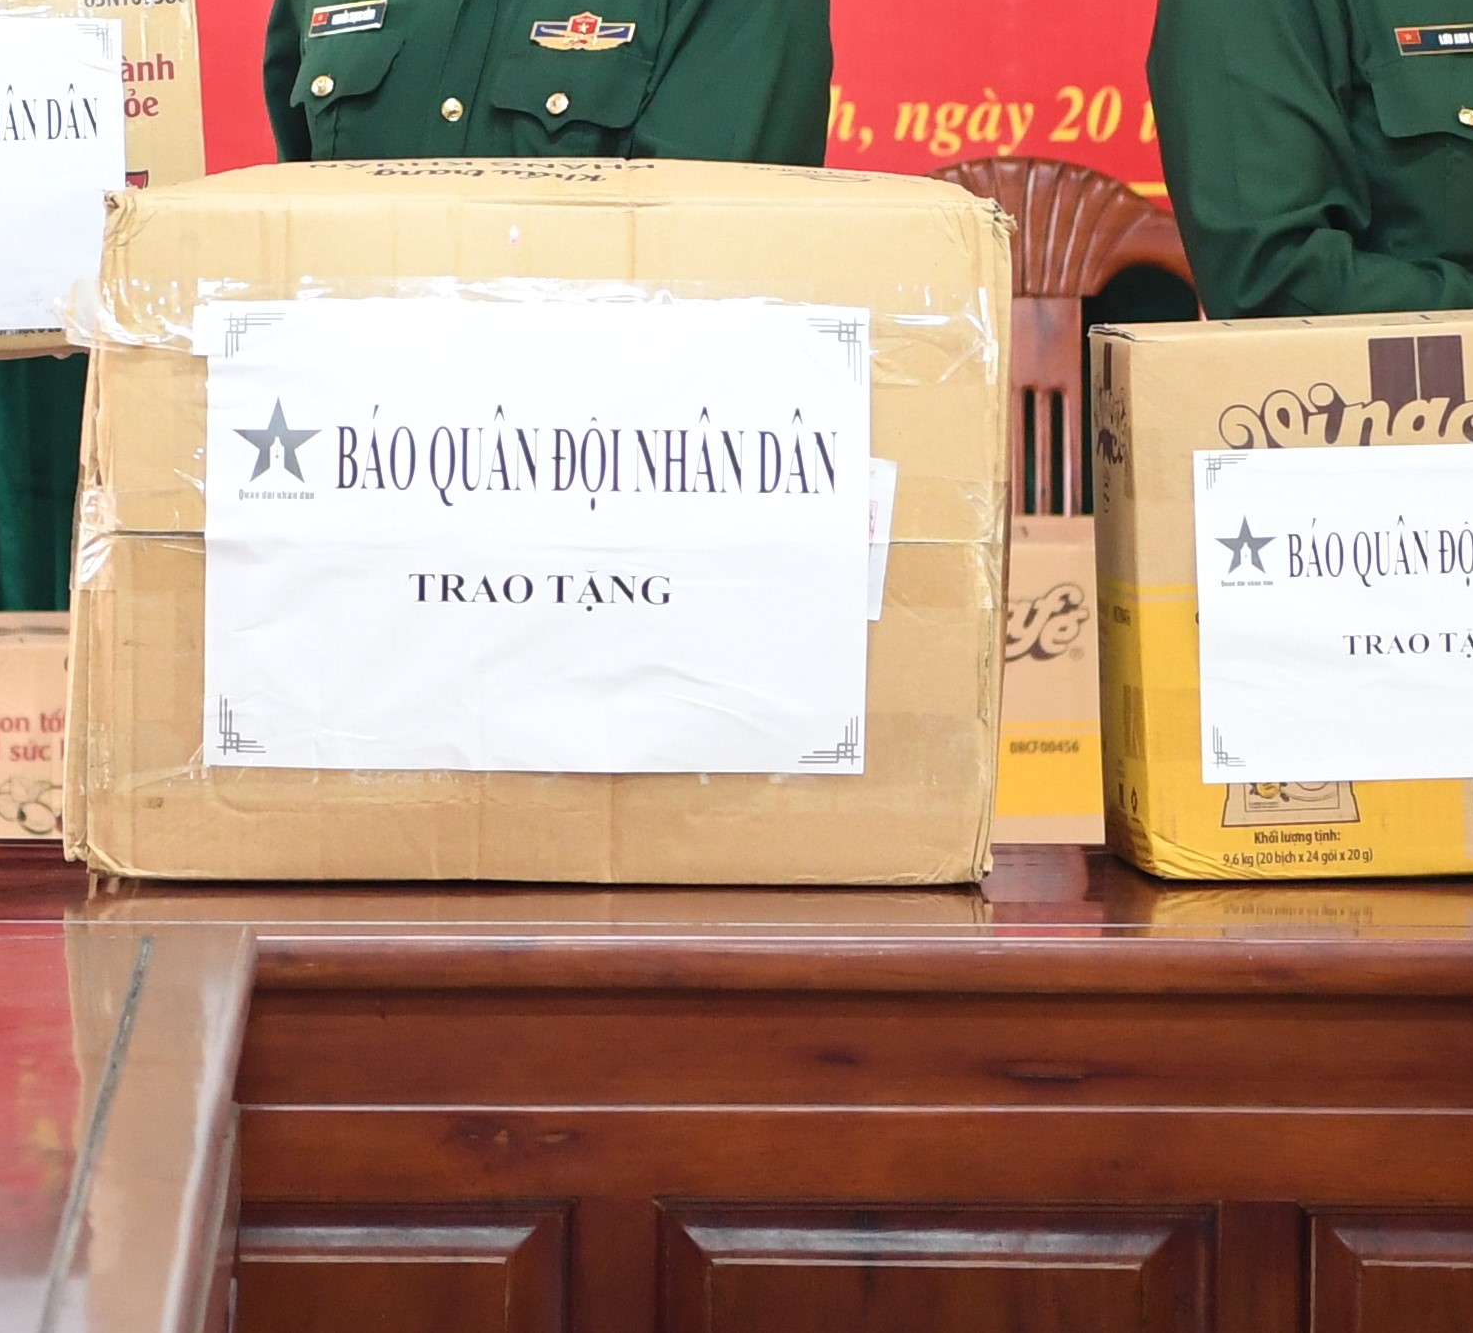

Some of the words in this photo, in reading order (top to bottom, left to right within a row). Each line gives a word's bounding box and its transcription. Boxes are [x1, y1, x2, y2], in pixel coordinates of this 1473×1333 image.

[46, 82, 99, 142] DÂN
[894, 86, 1035, 157] ngày
[1049, 85, 1122, 144] 20
[334, 403, 417, 492] BÁO
[429, 404, 540, 508] QUÂN
[551, 415, 622, 513] ĐỘI
[635, 405, 747, 496] NHÂN
[758, 406, 839, 497] DÂN
[1286, 518, 1346, 579] BÁO
[1352, 514, 1430, 587] QUÂN
[408, 571, 536, 606] TRAO
[547, 569, 674, 613] TẶNG
[1342, 633, 1431, 657] TRAO
[9, 739, 52, 762] sức
[1240, 852, 1254, 868] kg
[1255, 851, 1273, 867] (20
[1274, 850, 1297, 867] bịch
[1298, 853, 1305, 863] x
[1306, 850, 1319, 863] 24
[1321, 849, 1338, 866] gói
[1339, 852, 1346, 862] x
[1347, 848, 1361, 862] 20
[1362, 847, 1374, 865] g)
[1254, 828, 1279, 845] Khối
[1280, 830, 1313, 847] lượng
[1314, 828, 1342, 846] tịnh:
